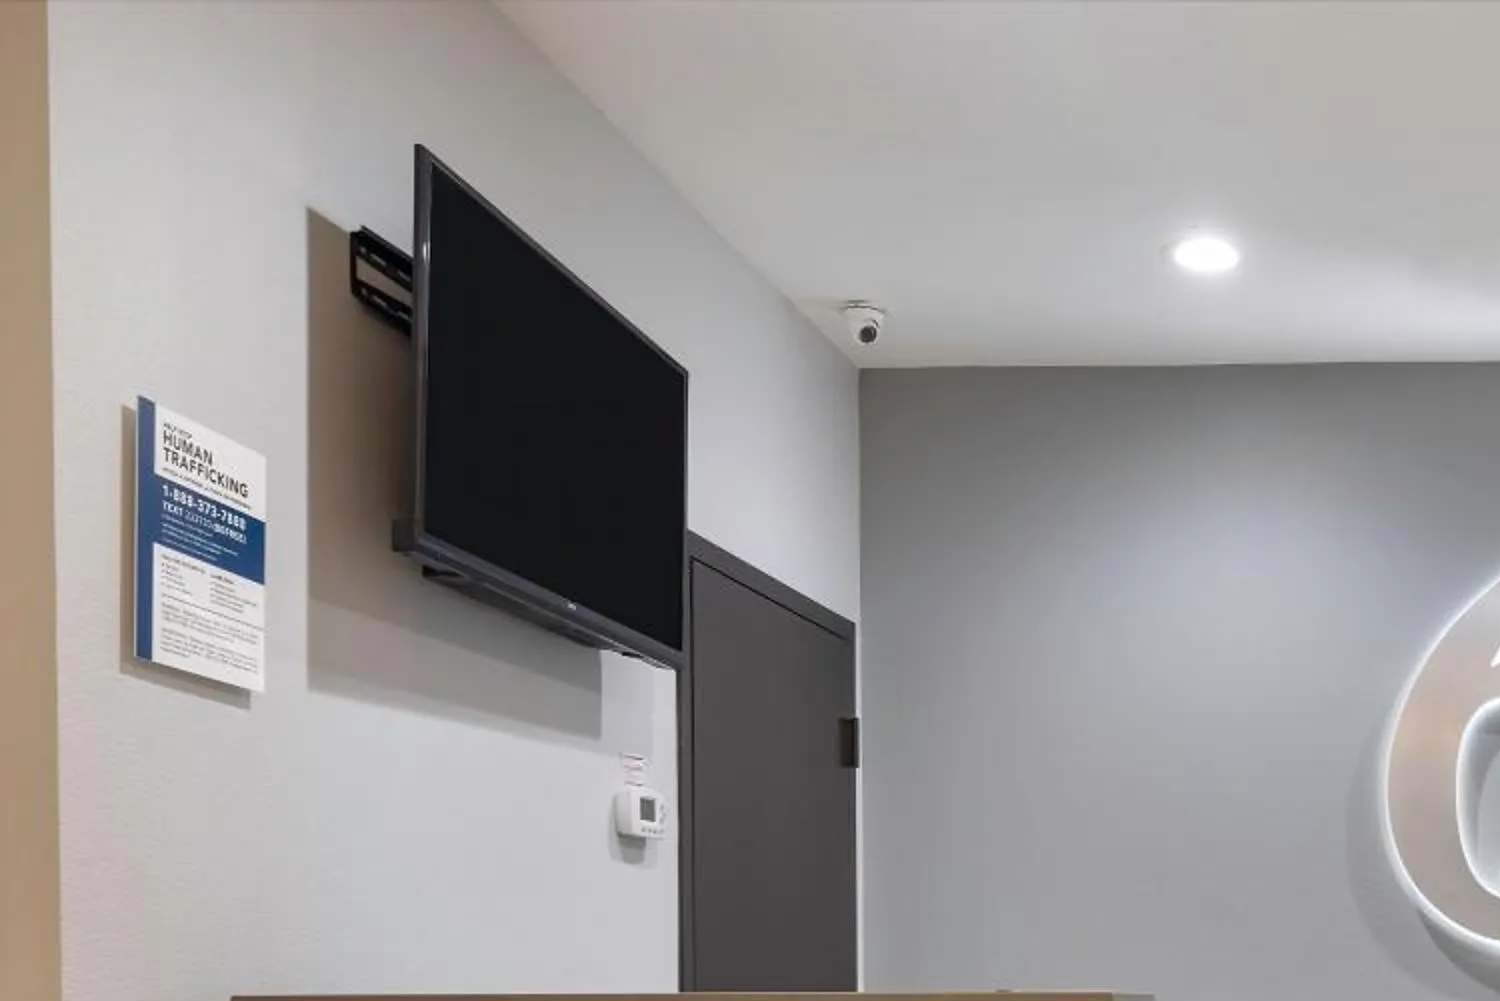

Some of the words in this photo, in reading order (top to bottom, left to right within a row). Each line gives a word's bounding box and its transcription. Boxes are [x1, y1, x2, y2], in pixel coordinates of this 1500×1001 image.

[163, 430, 213, 466] HUMAN
[163, 446, 249, 498] TRAFFICKING
[162, 500, 183, 517] TEXT
